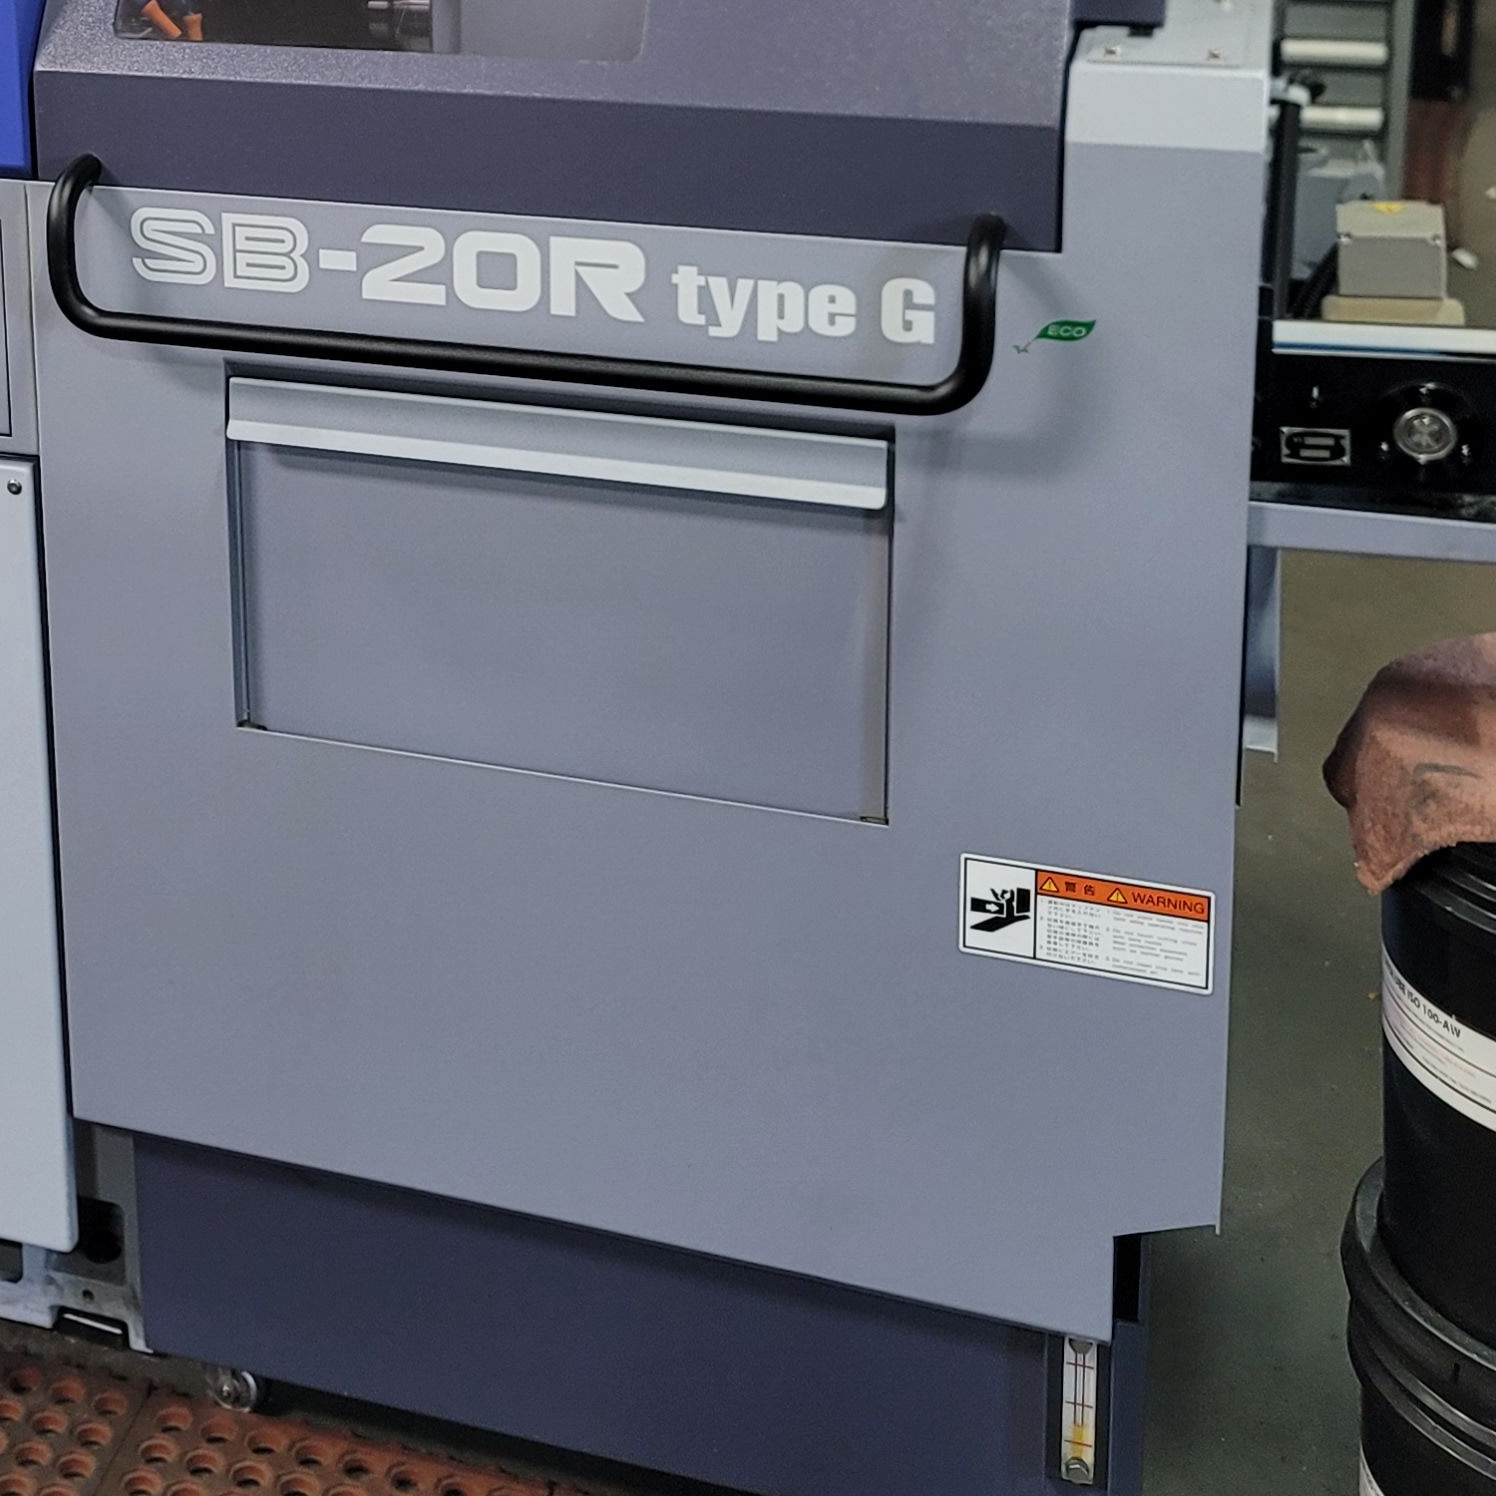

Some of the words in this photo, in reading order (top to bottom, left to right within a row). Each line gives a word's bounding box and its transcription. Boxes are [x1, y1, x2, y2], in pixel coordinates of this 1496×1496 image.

[129, 207, 647, 324] SB-20R
[671, 264, 858, 342] type
[880, 277, 936, 346] G
[1047, 324, 1087, 337] ECO
[1131, 891, 1205, 915] WARNING
